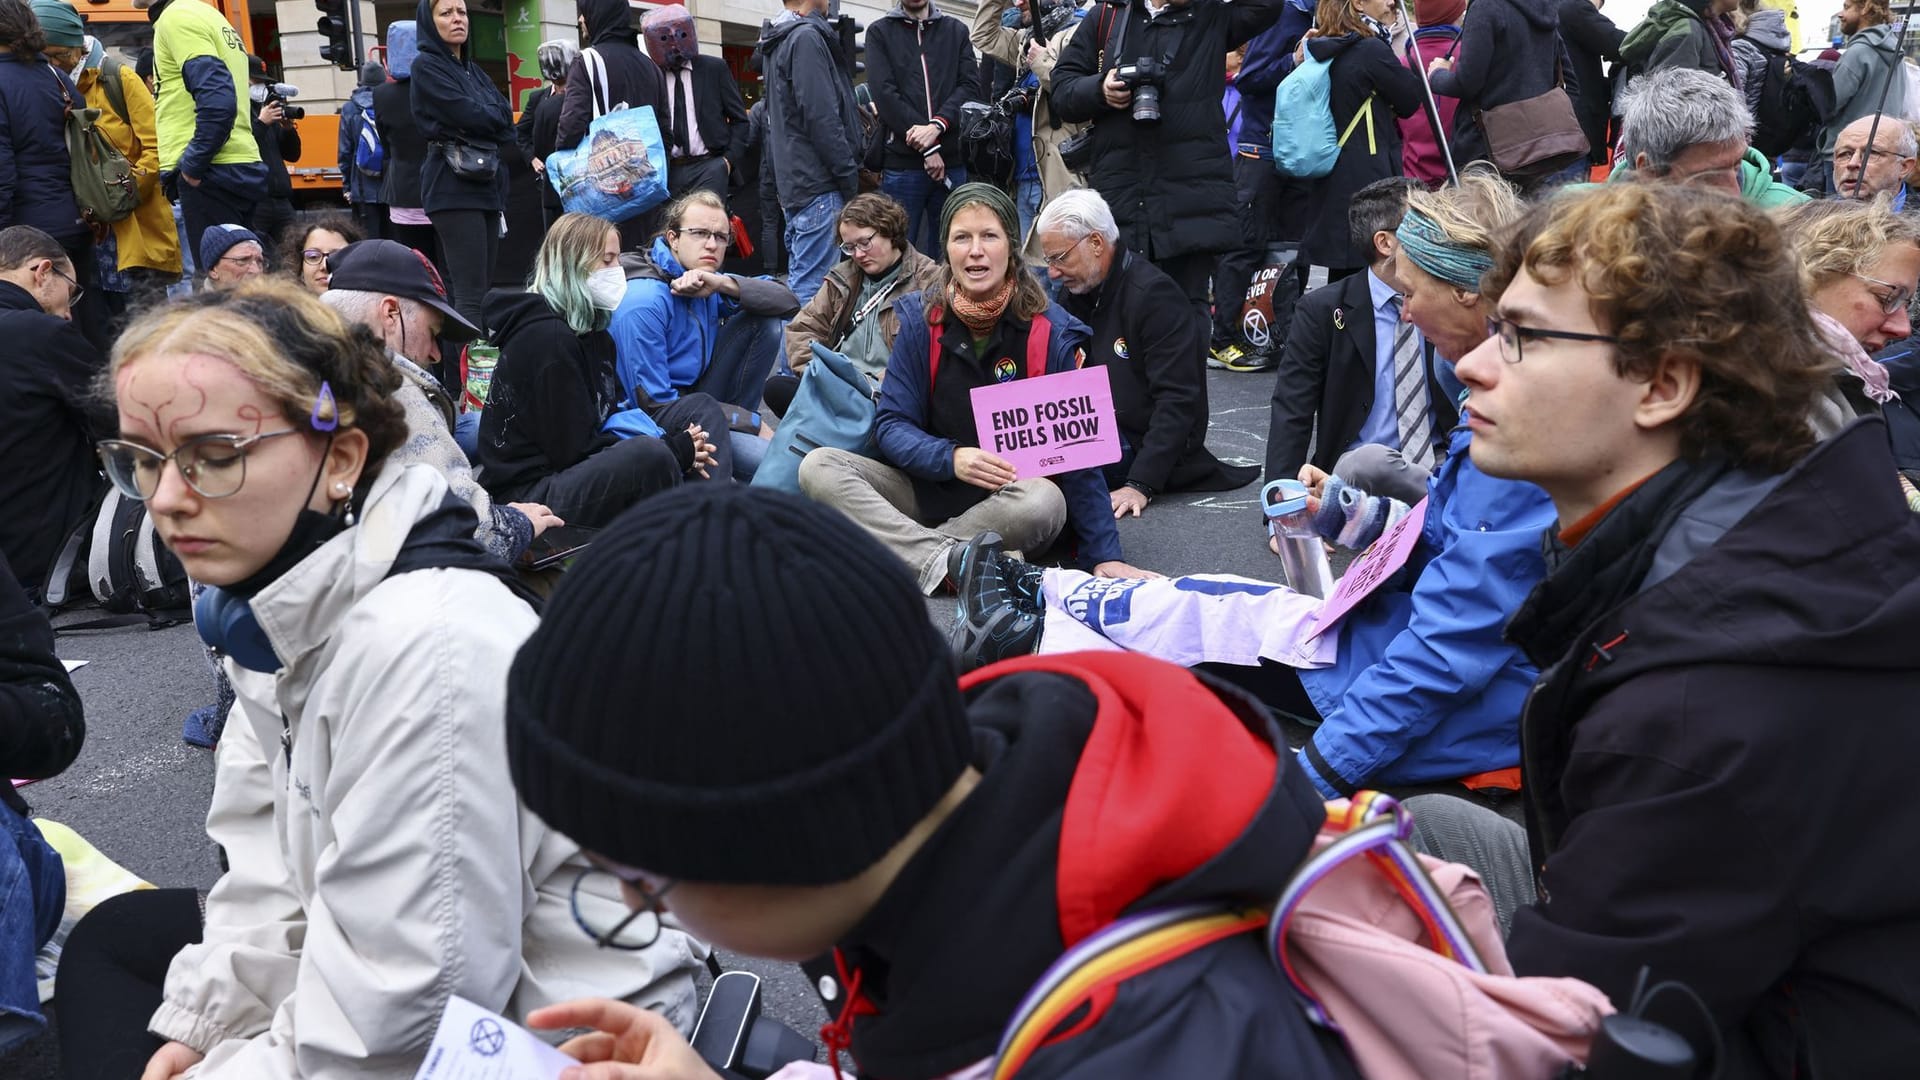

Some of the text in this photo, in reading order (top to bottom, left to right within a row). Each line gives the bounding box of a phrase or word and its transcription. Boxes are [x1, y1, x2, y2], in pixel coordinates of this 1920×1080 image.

[1261, 268, 1278, 280] OR
[991, 395, 1096, 430] END FOSSIL
[994, 416, 1099, 453] FUELS NOW
